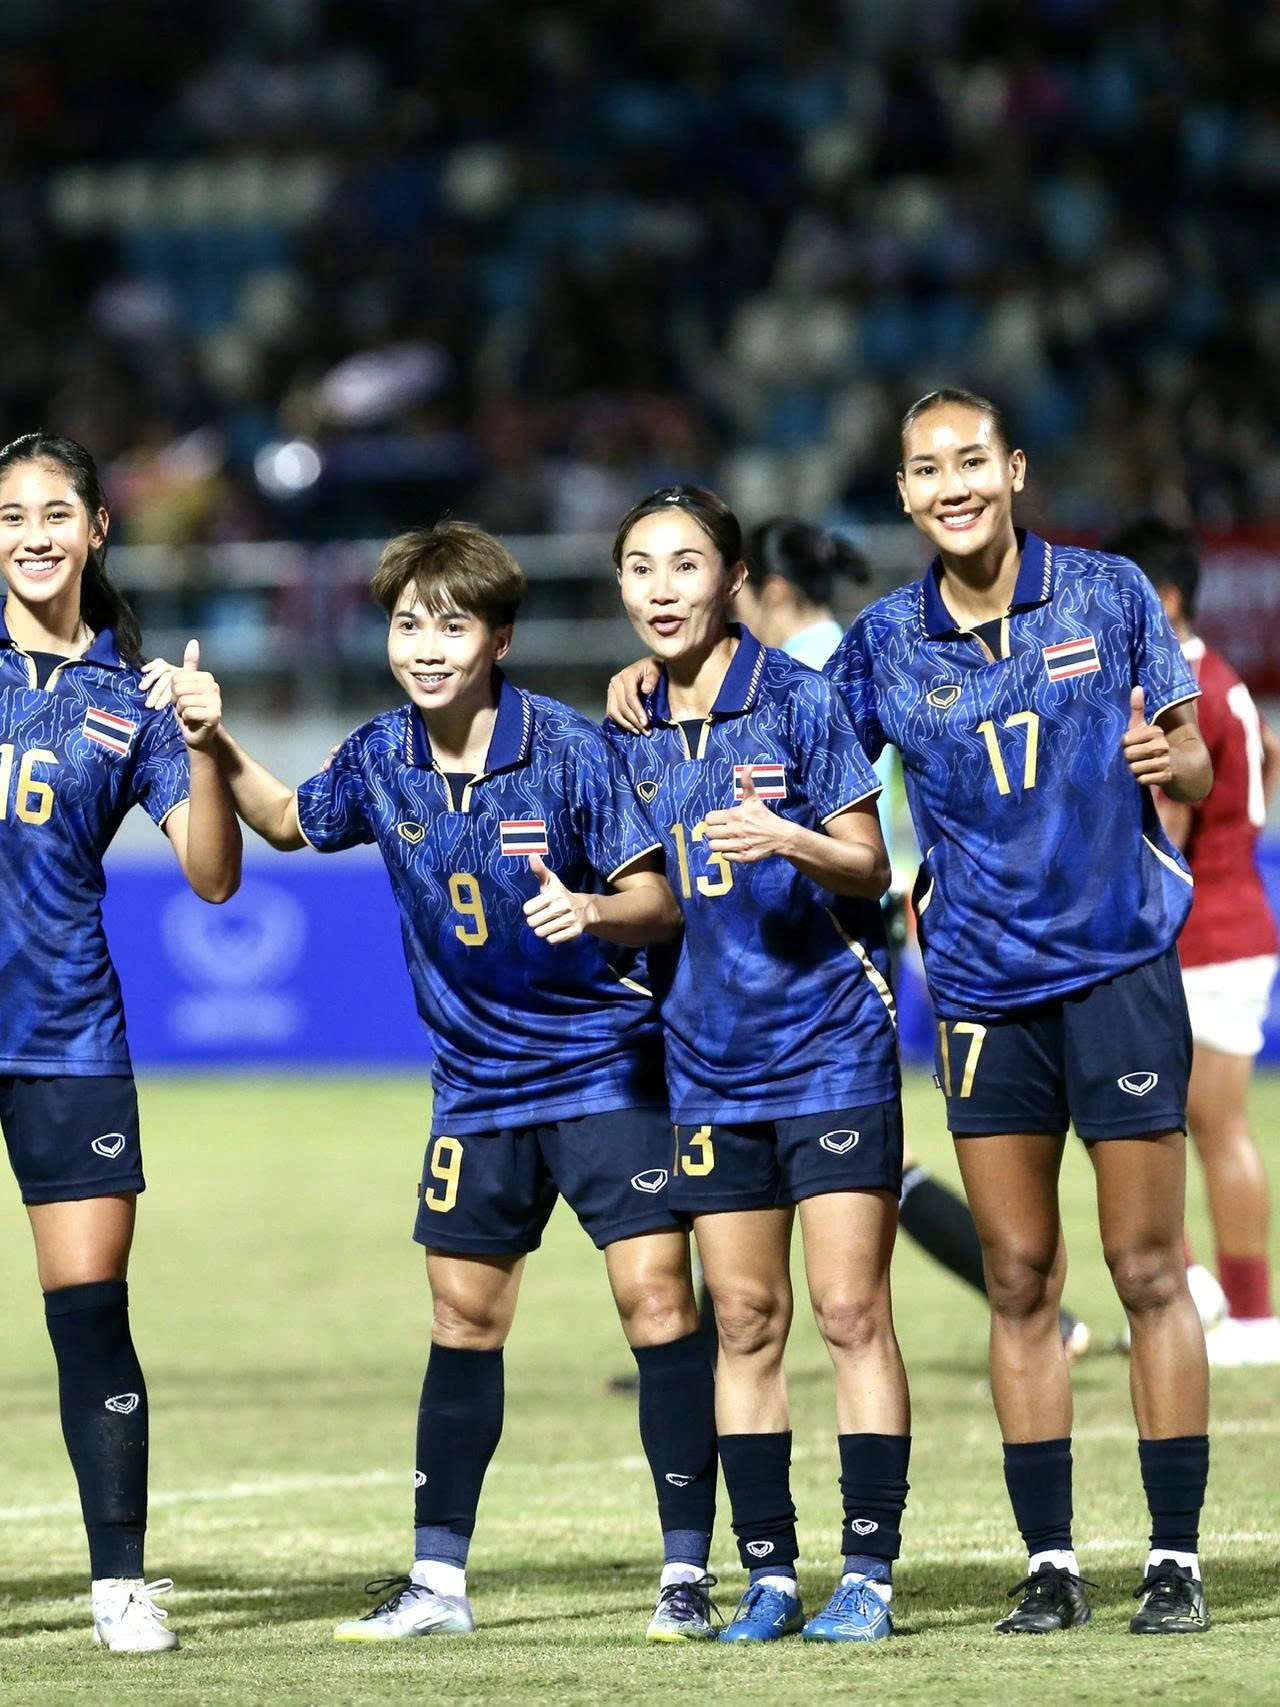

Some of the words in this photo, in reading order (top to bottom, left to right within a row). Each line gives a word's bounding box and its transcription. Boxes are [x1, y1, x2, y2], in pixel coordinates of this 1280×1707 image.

[977, 711, 1039, 795] 17
[670, 820, 733, 898] 13
[449, 873, 487, 946] 9
[938, 1021, 987, 1097] 17
[424, 1137, 463, 1212] 9
